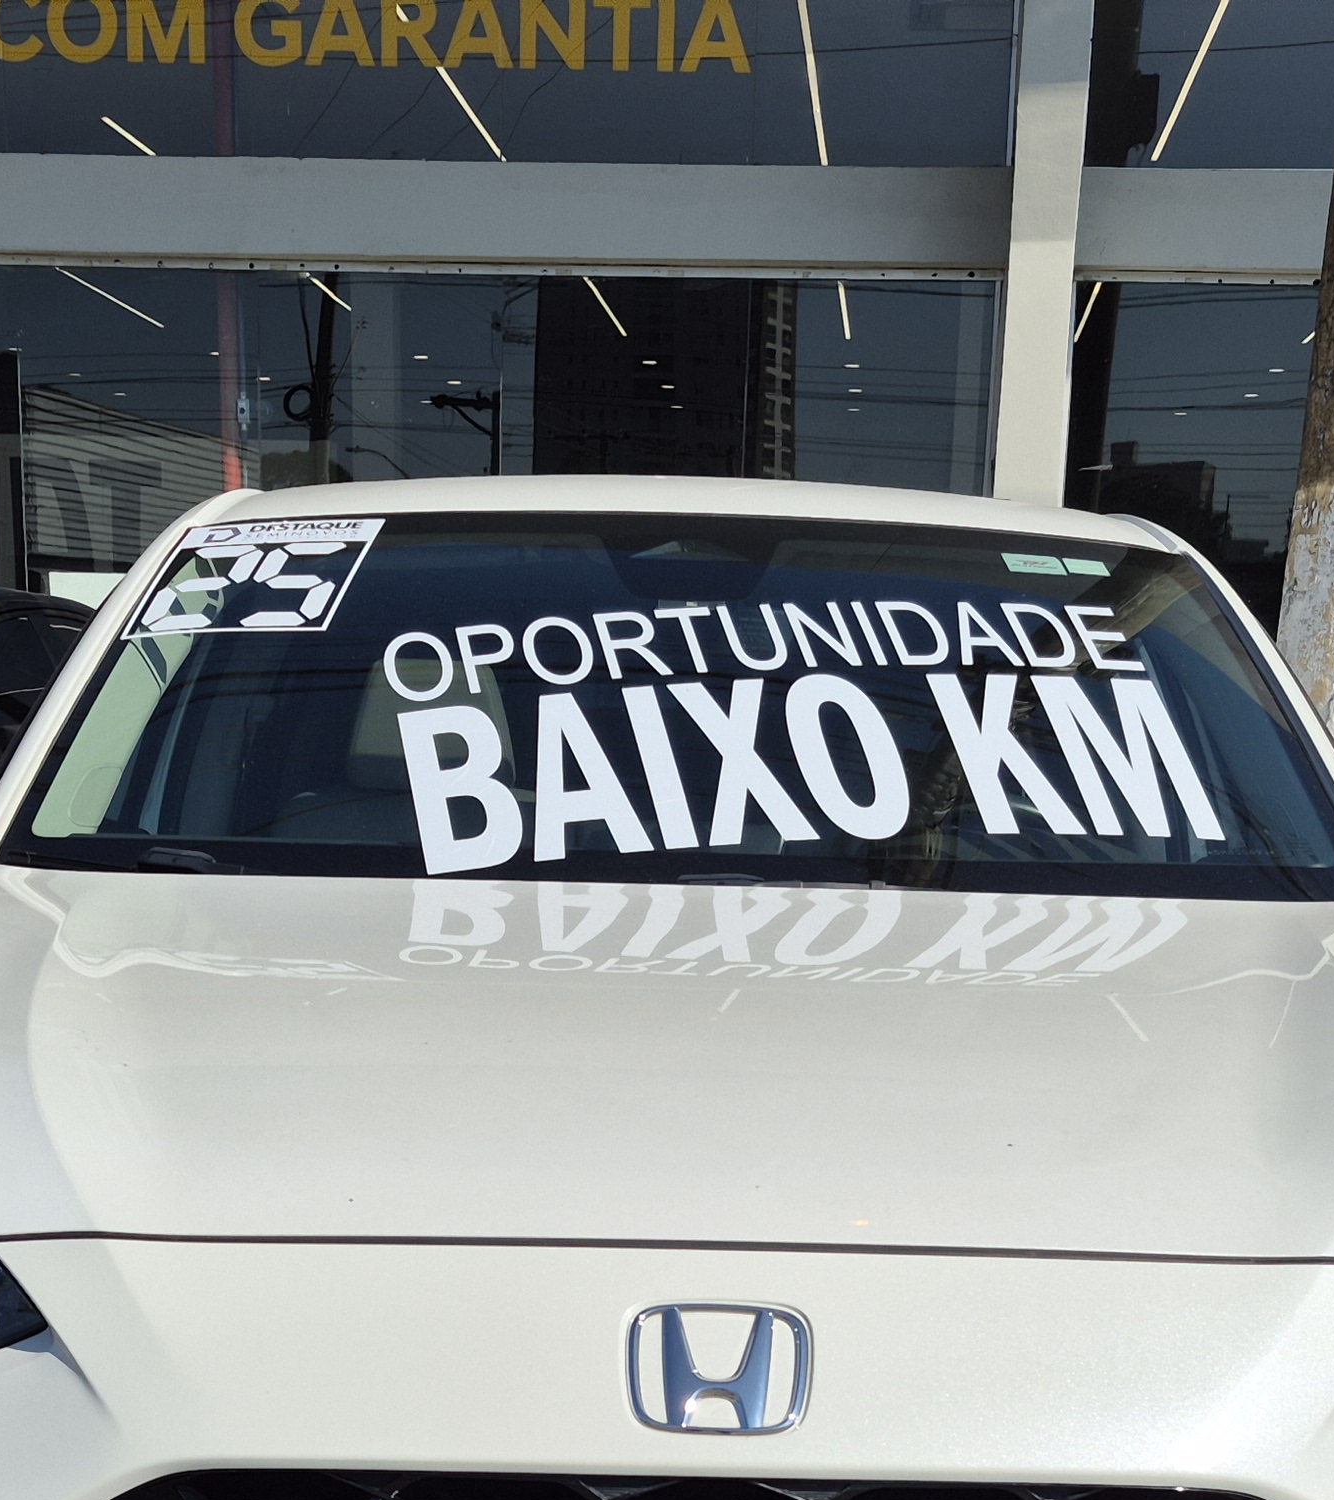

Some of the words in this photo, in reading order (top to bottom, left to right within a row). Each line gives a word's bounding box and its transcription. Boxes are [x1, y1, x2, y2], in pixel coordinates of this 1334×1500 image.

[233, 0, 751, 74] GARANTIA
[249, 521, 364, 533] DESTAQUE
[141, 542, 347, 632] 25
[382, 600, 1145, 702] OPORTUNIDADE
[397, 674, 910, 876] BAIXO
[926, 674, 1225, 841] KM
